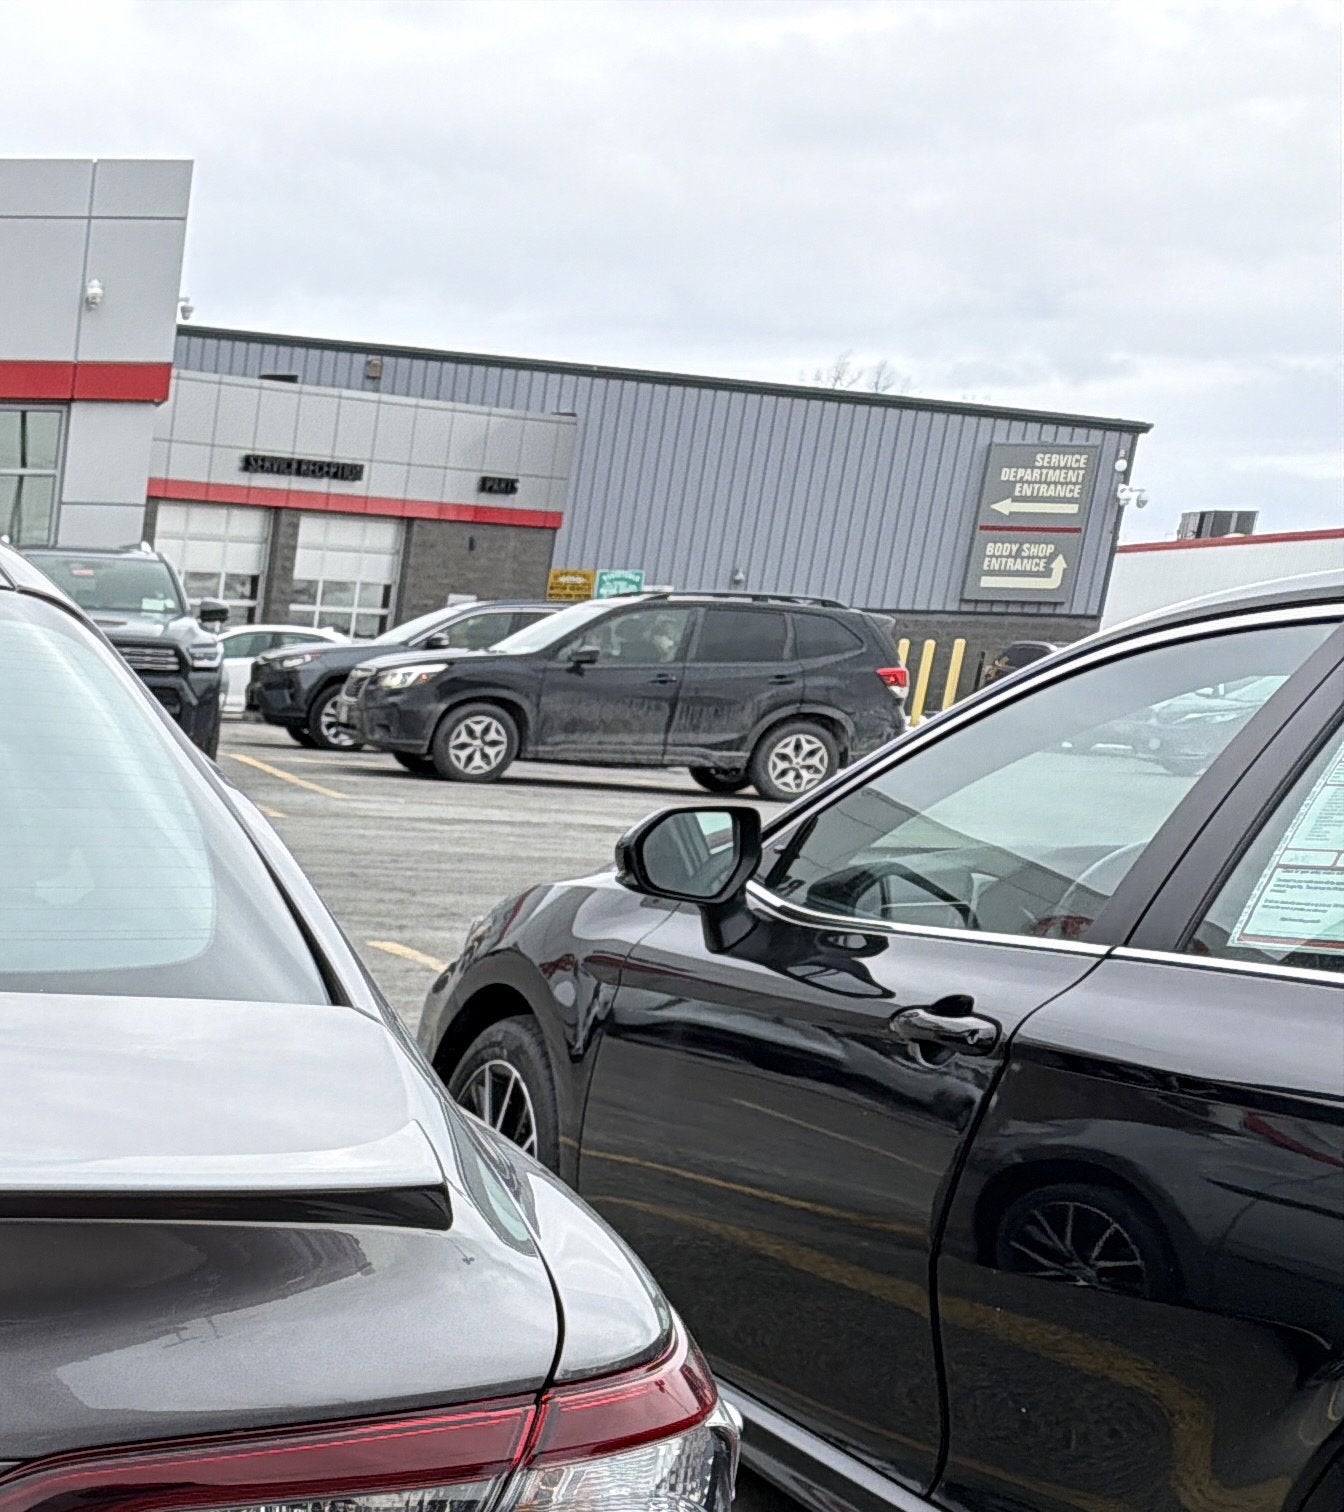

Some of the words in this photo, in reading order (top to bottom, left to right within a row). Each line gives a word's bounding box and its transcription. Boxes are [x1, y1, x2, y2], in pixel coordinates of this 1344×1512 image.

[1035, 453, 1088, 468] SERVICE
[1000, 467, 1086, 482] DEPARTMENT
[1014, 483, 1082, 497] ENTRANCE
[986, 542, 1019, 556] BODY
[1021, 543, 1055, 556] SHOP
[983, 557, 1047, 571] ENTRANCE
